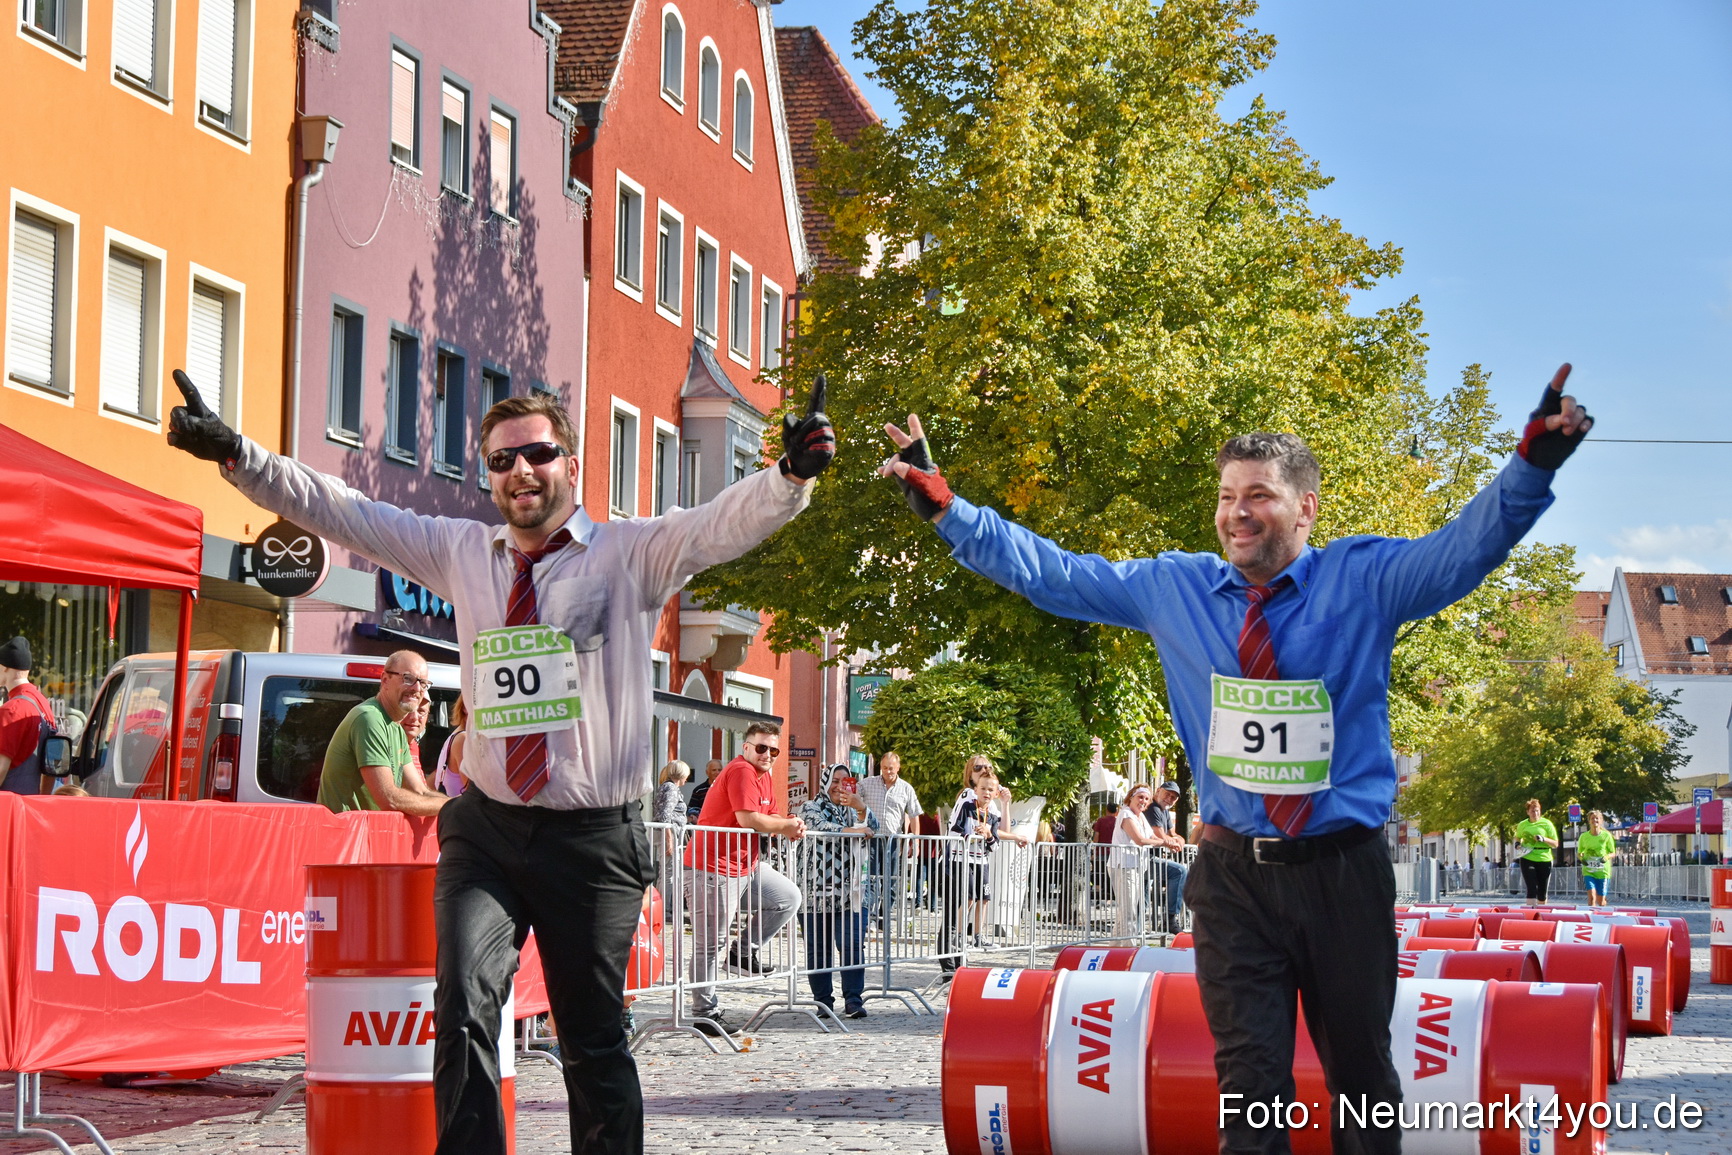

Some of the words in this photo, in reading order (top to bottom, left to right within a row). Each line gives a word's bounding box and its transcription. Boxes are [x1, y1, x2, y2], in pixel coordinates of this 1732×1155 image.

[257, 569, 317, 579] hunkemöller
[477, 629, 566, 660] BOCK
[494, 664, 540, 698] 90
[856, 683, 872, 693] vom
[861, 688, 882, 700] FAS
[1221, 681, 1322, 711] BOCK
[481, 703, 568, 726] MATTHIAS
[1242, 720, 1287, 754] 91
[790, 748, 814, 757] risgasse
[1232, 763, 1305, 780] ADRIAN
[788, 786, 808, 798] EZIA
[261, 909, 305, 944] ene
